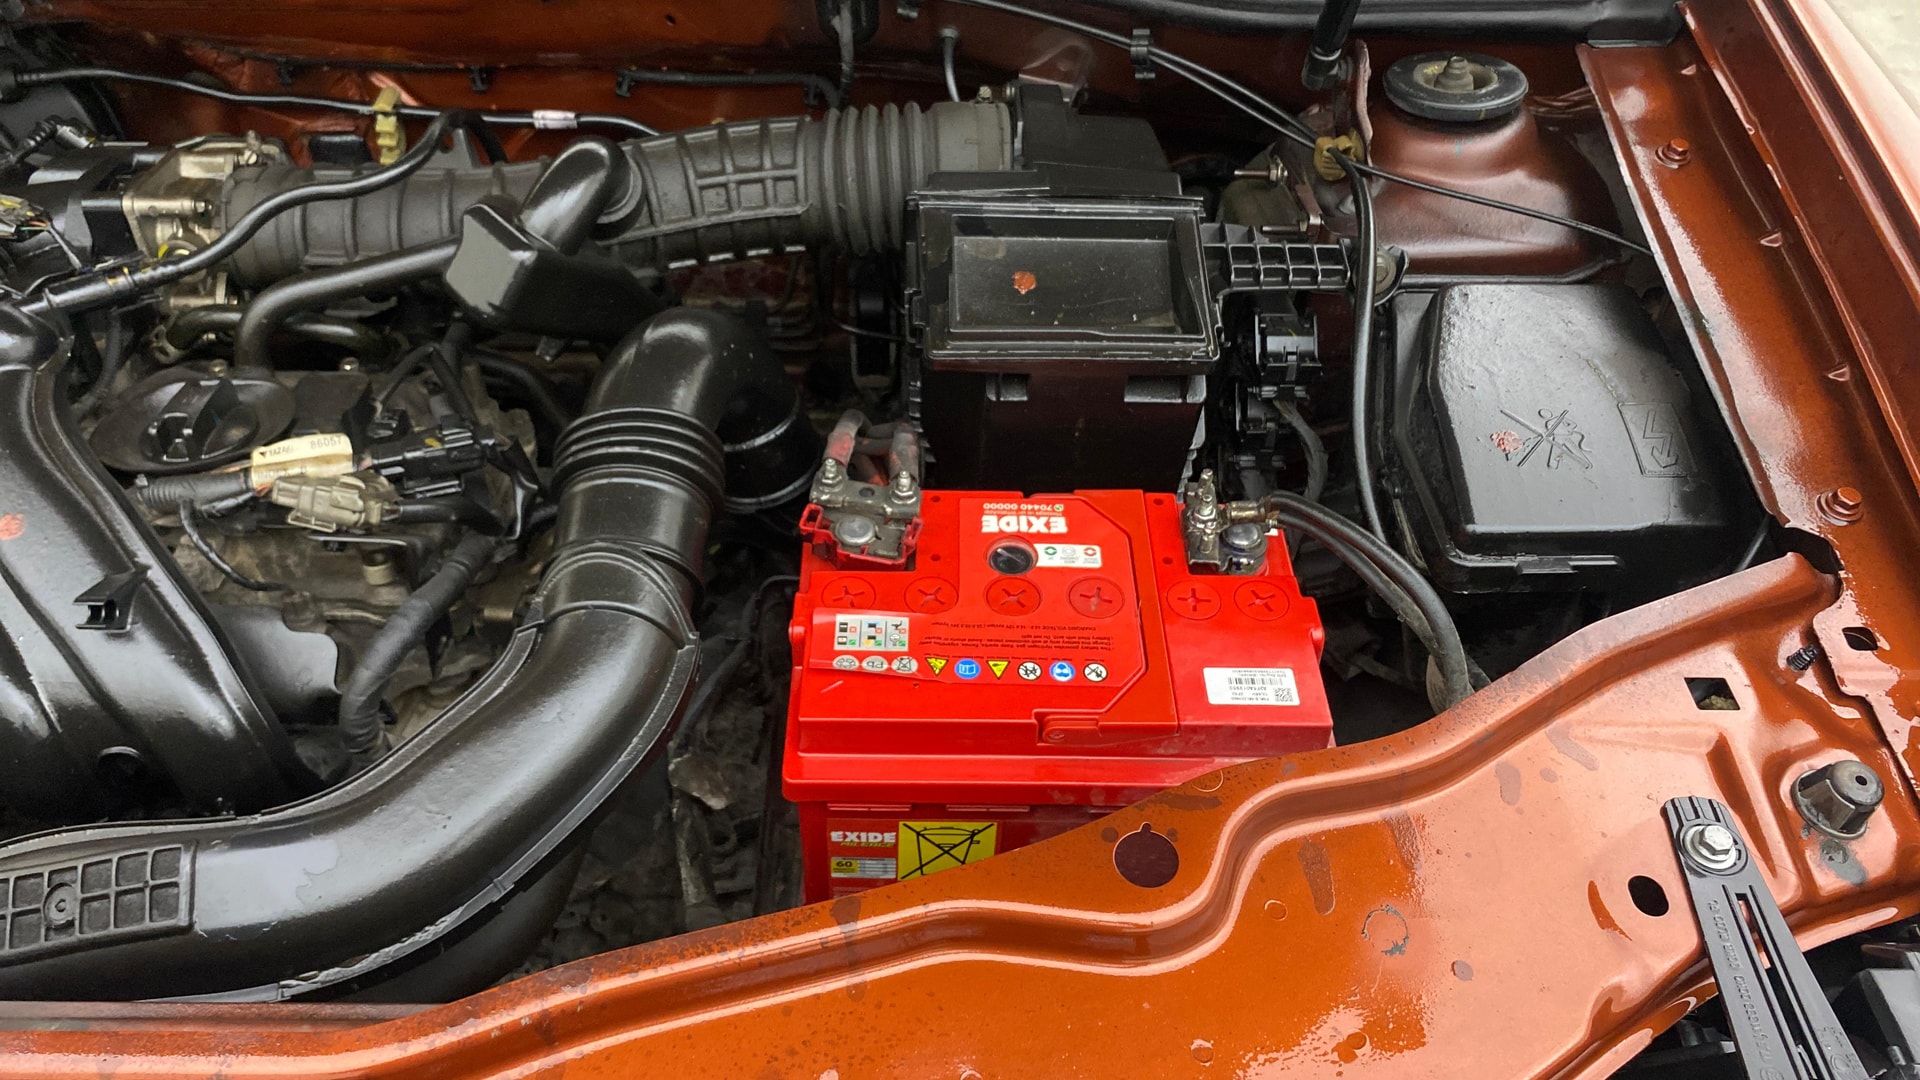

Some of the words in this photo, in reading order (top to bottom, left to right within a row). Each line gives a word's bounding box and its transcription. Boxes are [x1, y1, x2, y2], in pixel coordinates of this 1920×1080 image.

[981, 515, 1068, 533] EXIDE
[866, 660, 884, 669] Pb
[830, 831, 896, 843] EXIDE
